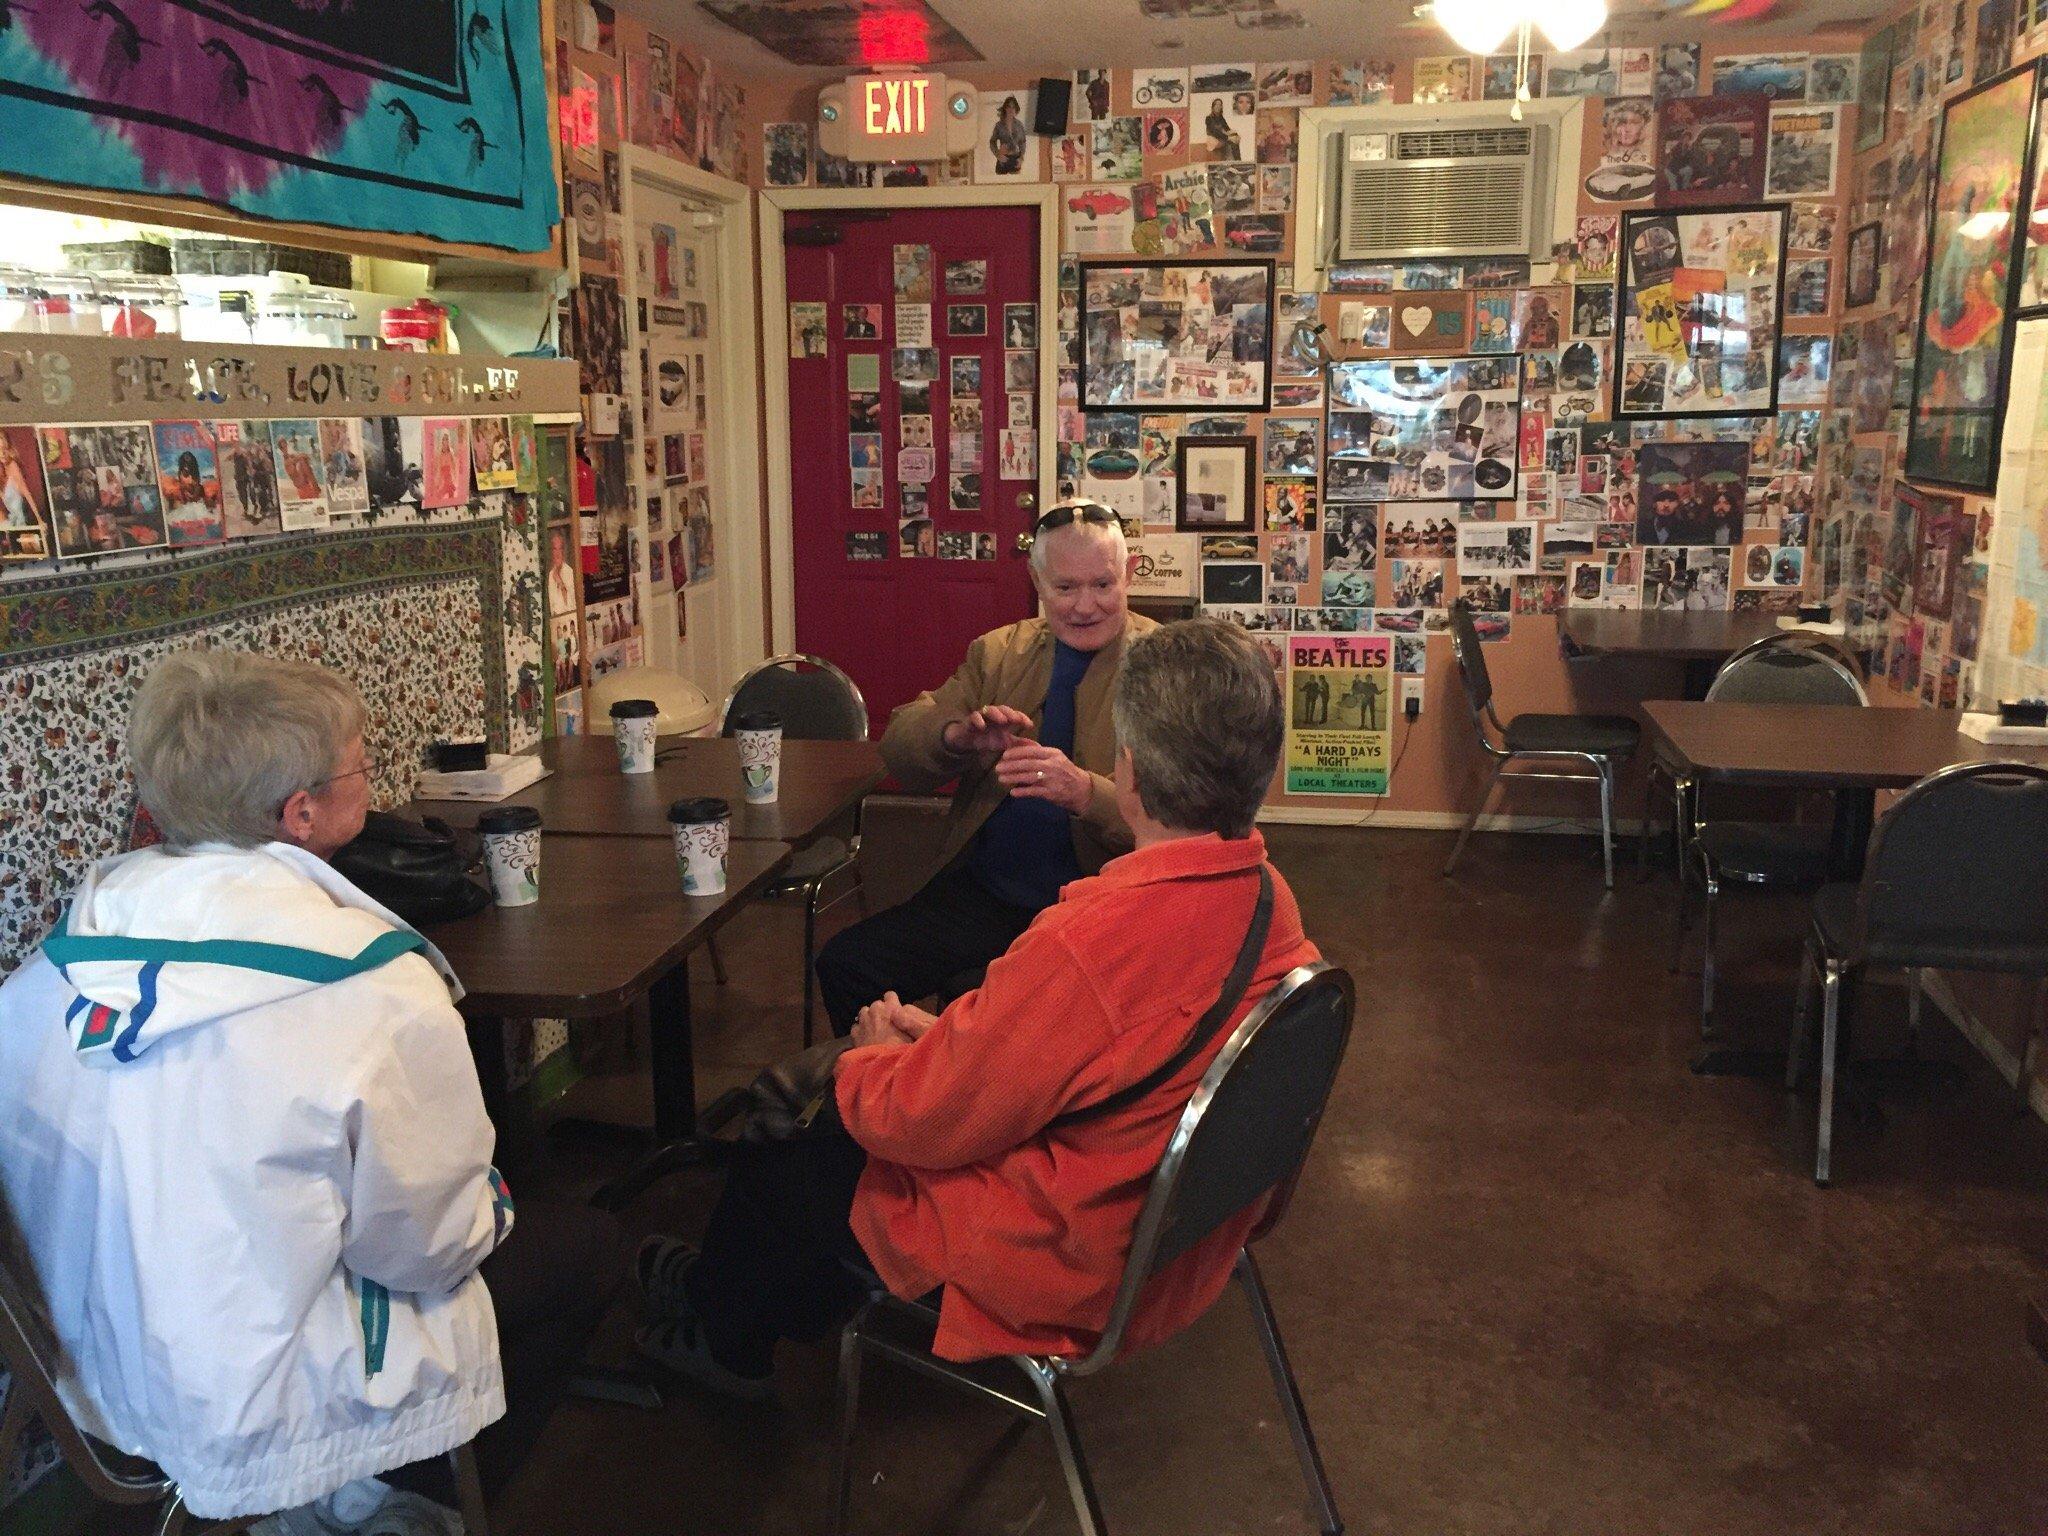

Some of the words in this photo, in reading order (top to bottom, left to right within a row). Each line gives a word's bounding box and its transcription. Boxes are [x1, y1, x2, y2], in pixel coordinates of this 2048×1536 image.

[865, 80, 929, 133] EXIT
[1165, 170, 1205, 191] Archie
[286, 361, 380, 405] LOVE
[217, 424, 239, 442] LIFE
[326, 483, 366, 505] Vespa
[1294, 648, 1387, 668] BEATLES
[1315, 745, 1346, 756] HARD
[1350, 746, 1381, 757] DAYS
[1317, 756, 1359, 767] NIGHT"
[1298, 778, 1325, 787] LOCAL
[1331, 779, 1377, 788] THEATERS
